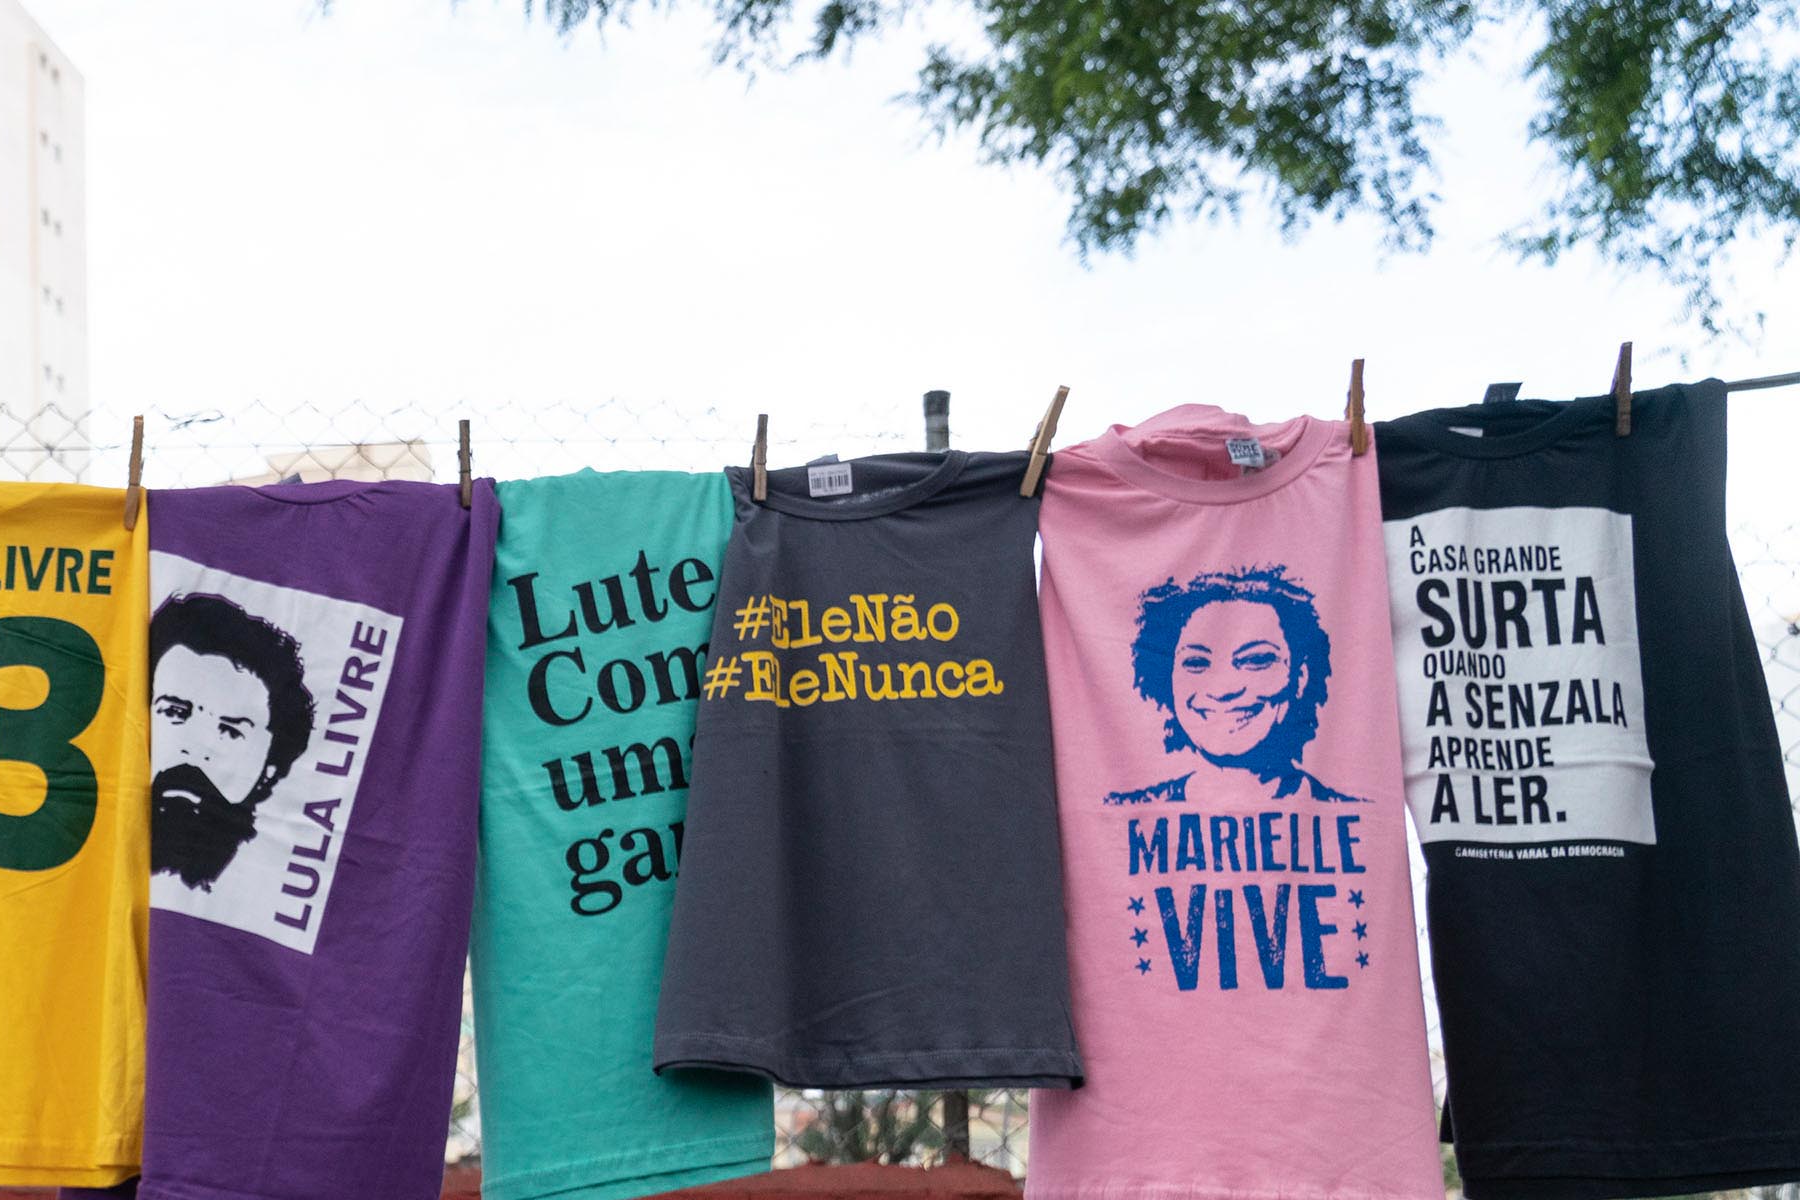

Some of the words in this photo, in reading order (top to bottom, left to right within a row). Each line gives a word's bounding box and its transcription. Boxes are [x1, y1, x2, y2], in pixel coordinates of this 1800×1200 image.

[1409, 525, 1426, 548] A
[1410, 545, 1469, 575] CASA
[1474, 546, 1562, 574] GRANDE
[507, 550, 715, 650] Lute
[734, 594, 960, 649] #EleNão
[1416, 576, 1606, 649] SURTA
[1423, 650, 1506, 679] QUANDO
[1426, 681, 1453, 727] A
[1465, 678, 1628, 729] SENZALA
[274, 797, 342, 932] LULA
[315, 620, 387, 777] LIVRE
[542, 731, 697, 812] um
[1428, 736, 1554, 770] APRENDE
[1430, 773, 1460, 825] A
[1472, 775, 1567, 826] LER.
[565, 818, 685, 917] ga
[1128, 812, 1366, 875] MARIELLE
[1154, 883, 1349, 991] VIVE
